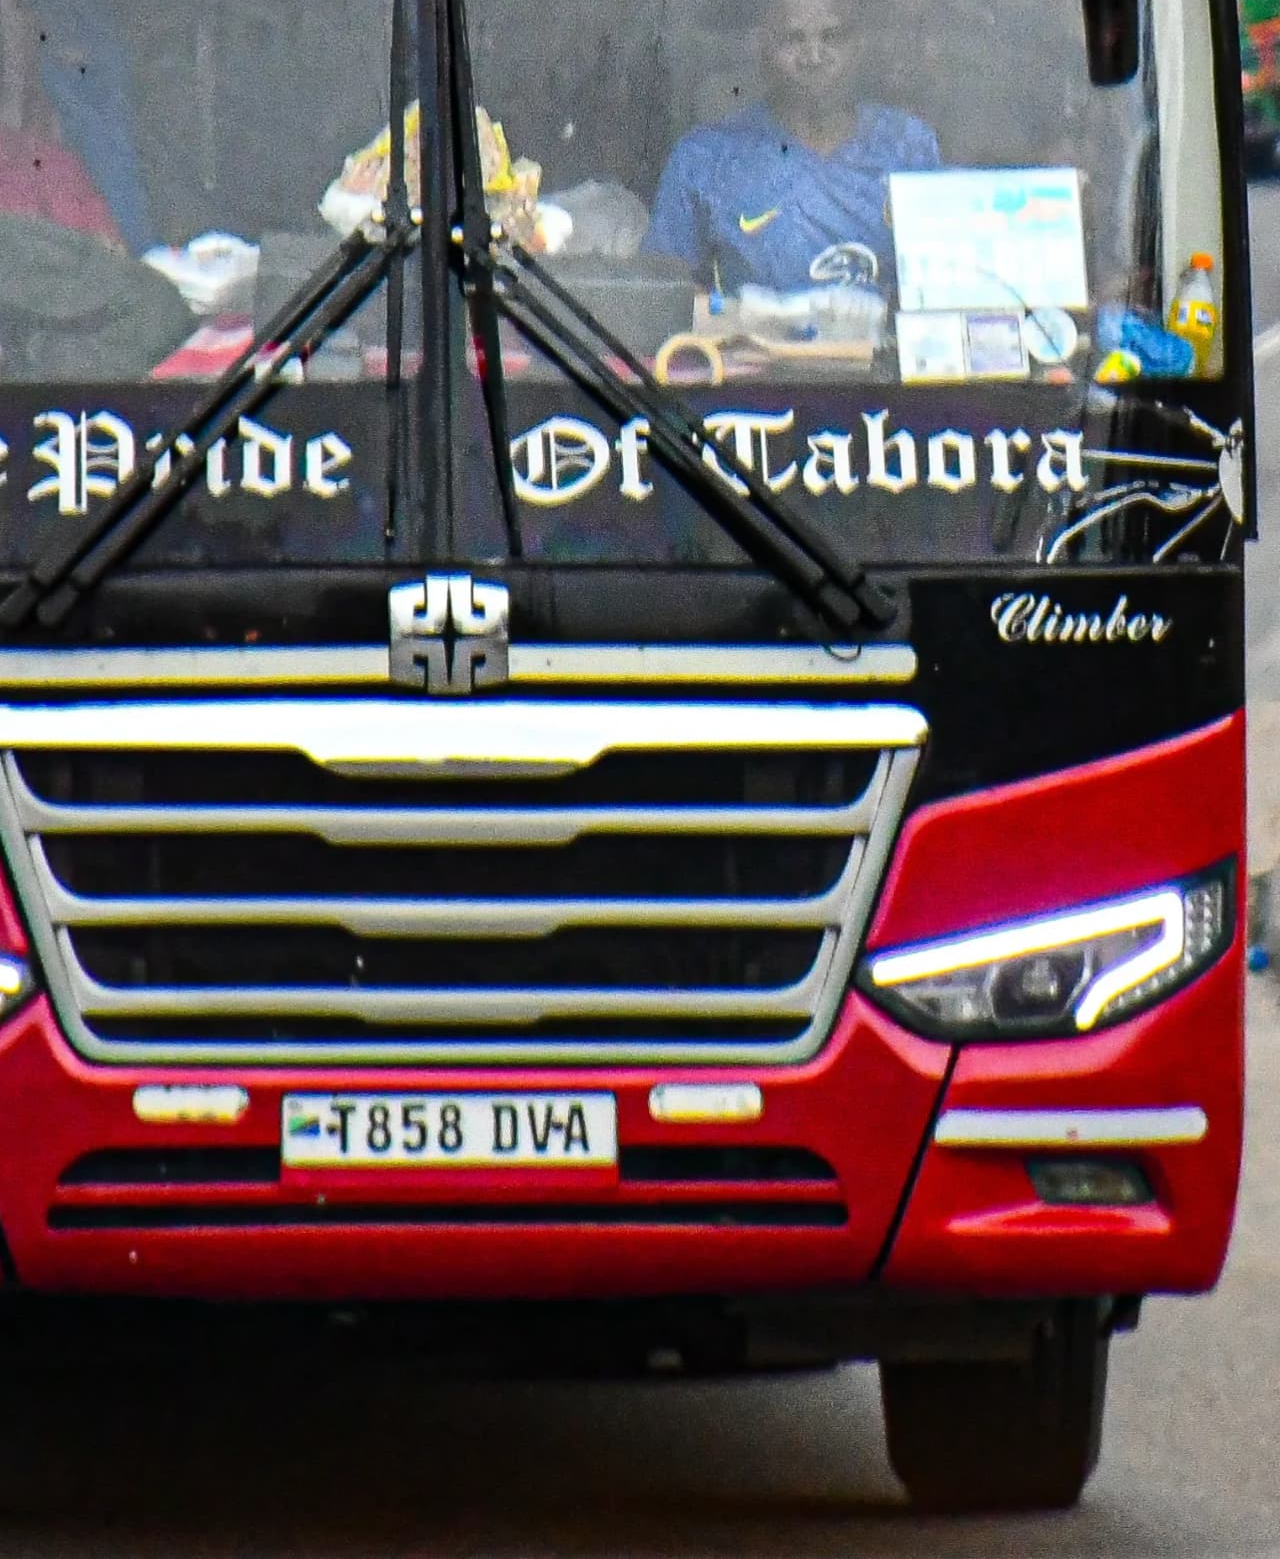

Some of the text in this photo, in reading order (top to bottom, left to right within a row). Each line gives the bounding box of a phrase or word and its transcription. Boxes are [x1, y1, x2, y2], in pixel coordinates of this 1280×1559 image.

[508, 413, 653, 508] Of
[692, 407, 1090, 499] Tabora
[989, 591, 1173, 643] Climber
[329, 1100, 592, 1155] T858 DVA
